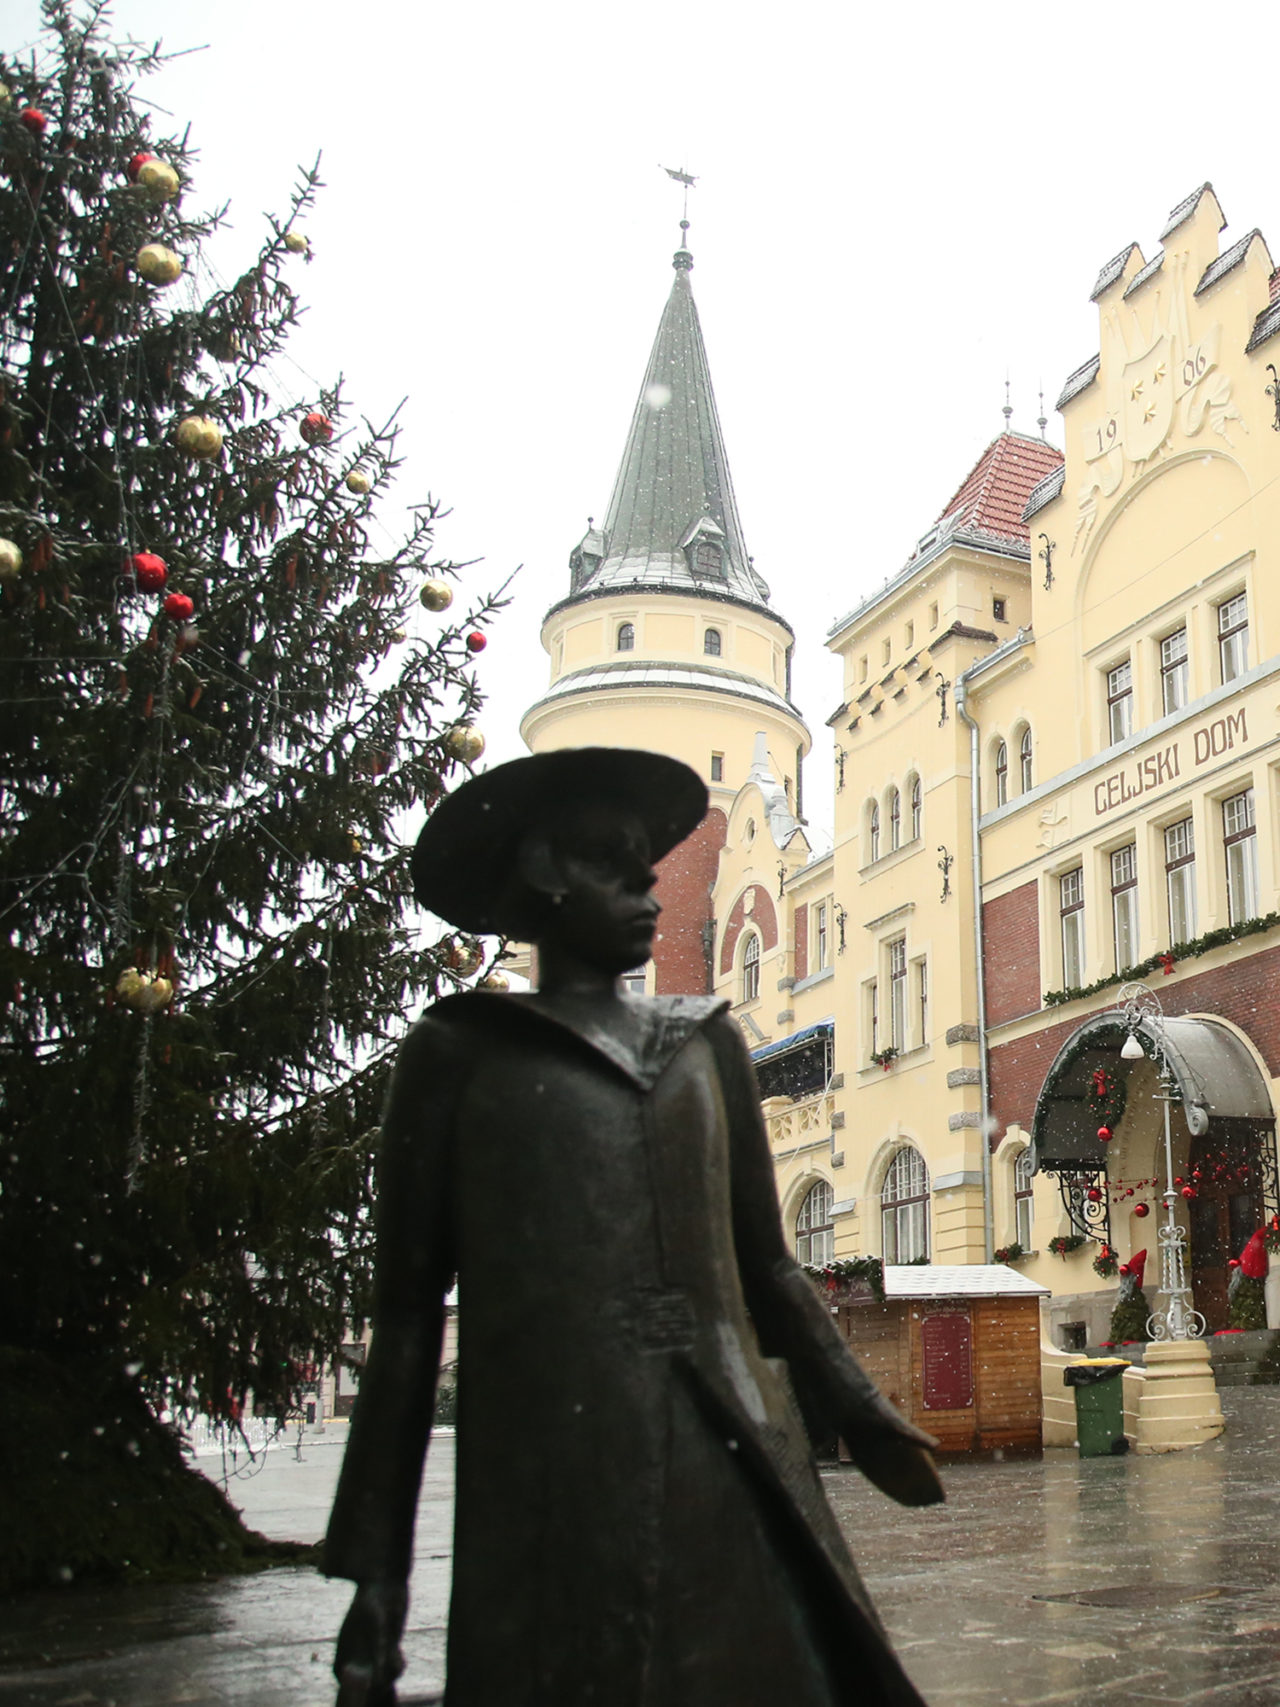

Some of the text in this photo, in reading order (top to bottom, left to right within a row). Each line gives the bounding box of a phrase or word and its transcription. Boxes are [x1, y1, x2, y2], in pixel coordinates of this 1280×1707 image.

[1096, 345, 1206, 452] 19 06
[1094, 707, 1248, 815] CELJSKI DOM
